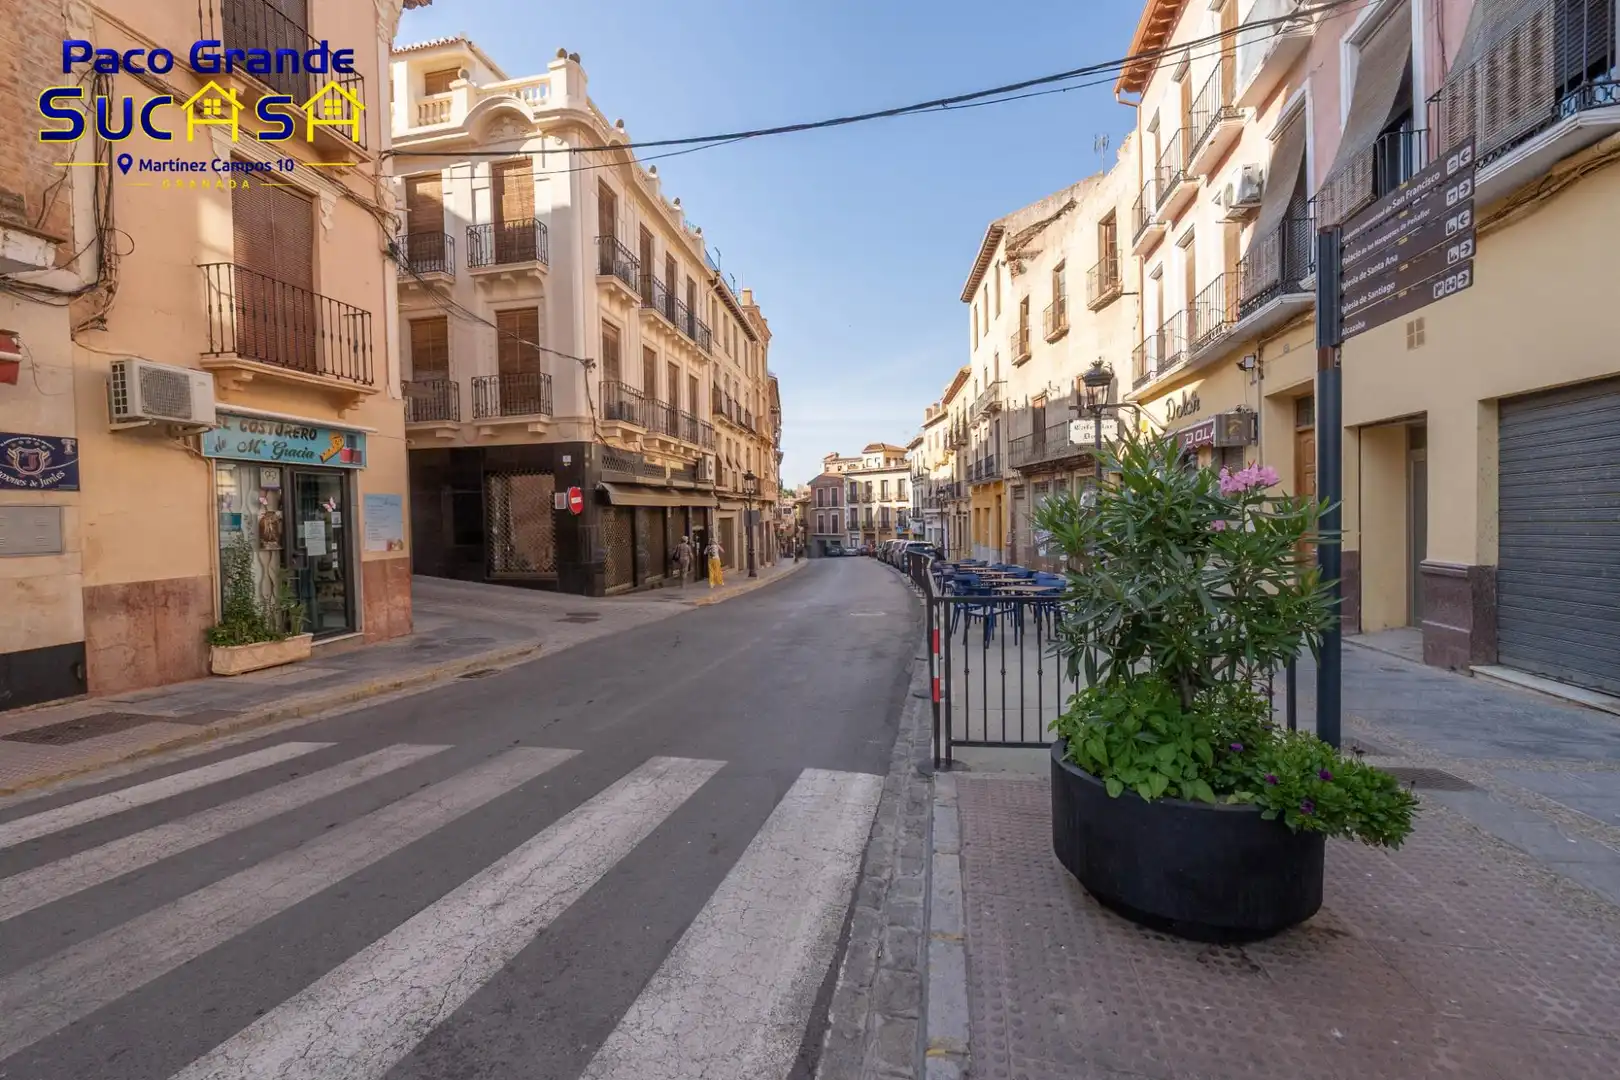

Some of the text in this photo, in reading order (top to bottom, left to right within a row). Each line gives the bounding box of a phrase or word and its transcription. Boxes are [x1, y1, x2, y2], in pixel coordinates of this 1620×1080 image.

[1392, 196, 1405, 209] San
[1405, 172, 1440, 199] Francisco
[1341, 254, 1398, 291] Iglesia de Santa Ana
[1341, 282, 1396, 314] Iglesia de Santiago
[270, 440, 315, 460] Gracia
